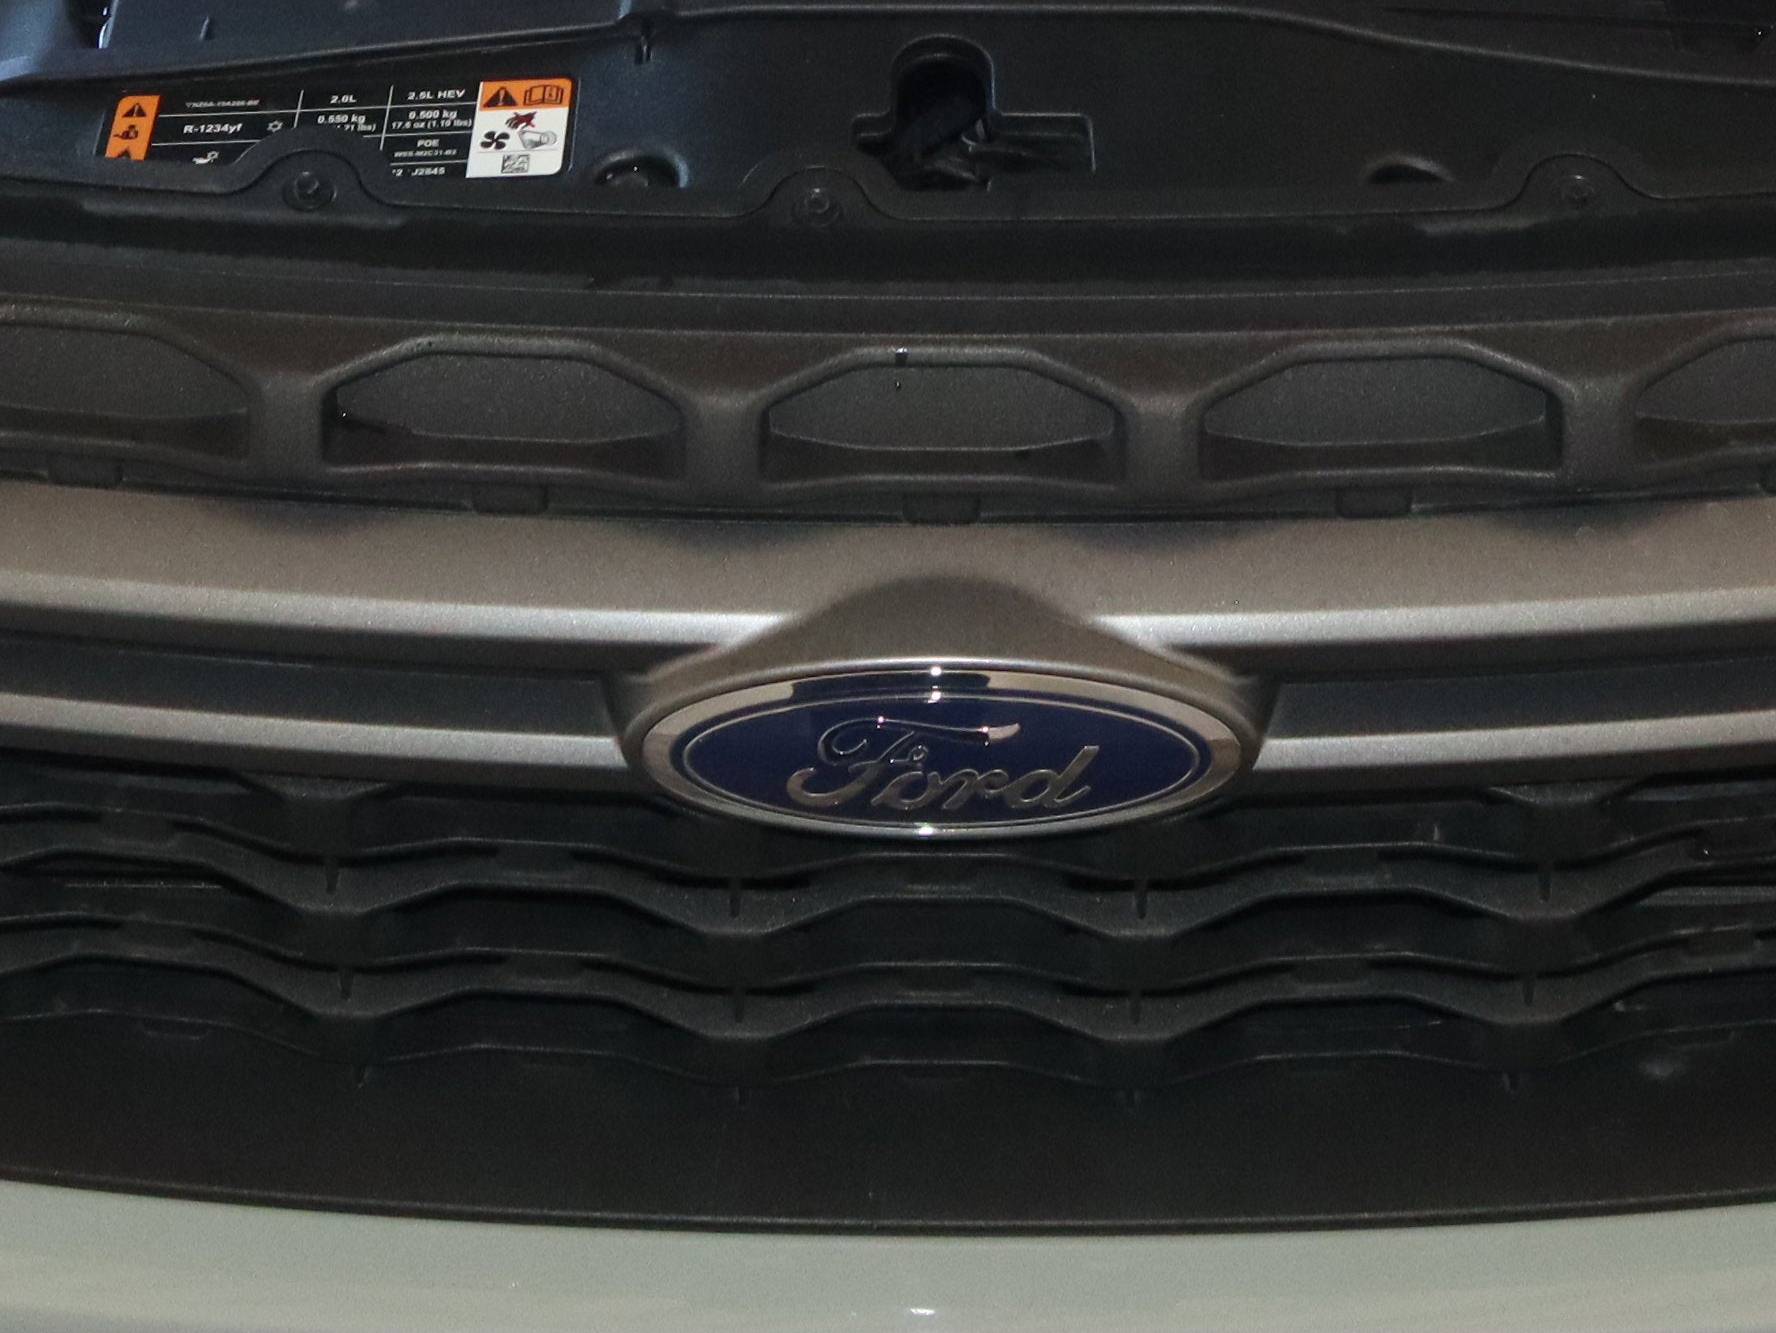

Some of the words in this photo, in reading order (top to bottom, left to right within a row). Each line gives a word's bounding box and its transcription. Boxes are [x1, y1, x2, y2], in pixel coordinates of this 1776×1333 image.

[330, 94, 357, 104] 2.0L
[437, 88, 466, 99] HEV
[350, 113, 366, 124] kg
[442, 108, 458, 120] kg
[183, 122, 243, 134] R-1234yf
[416, 138, 440, 148] POE
[785, 716, 1101, 811] Ford
